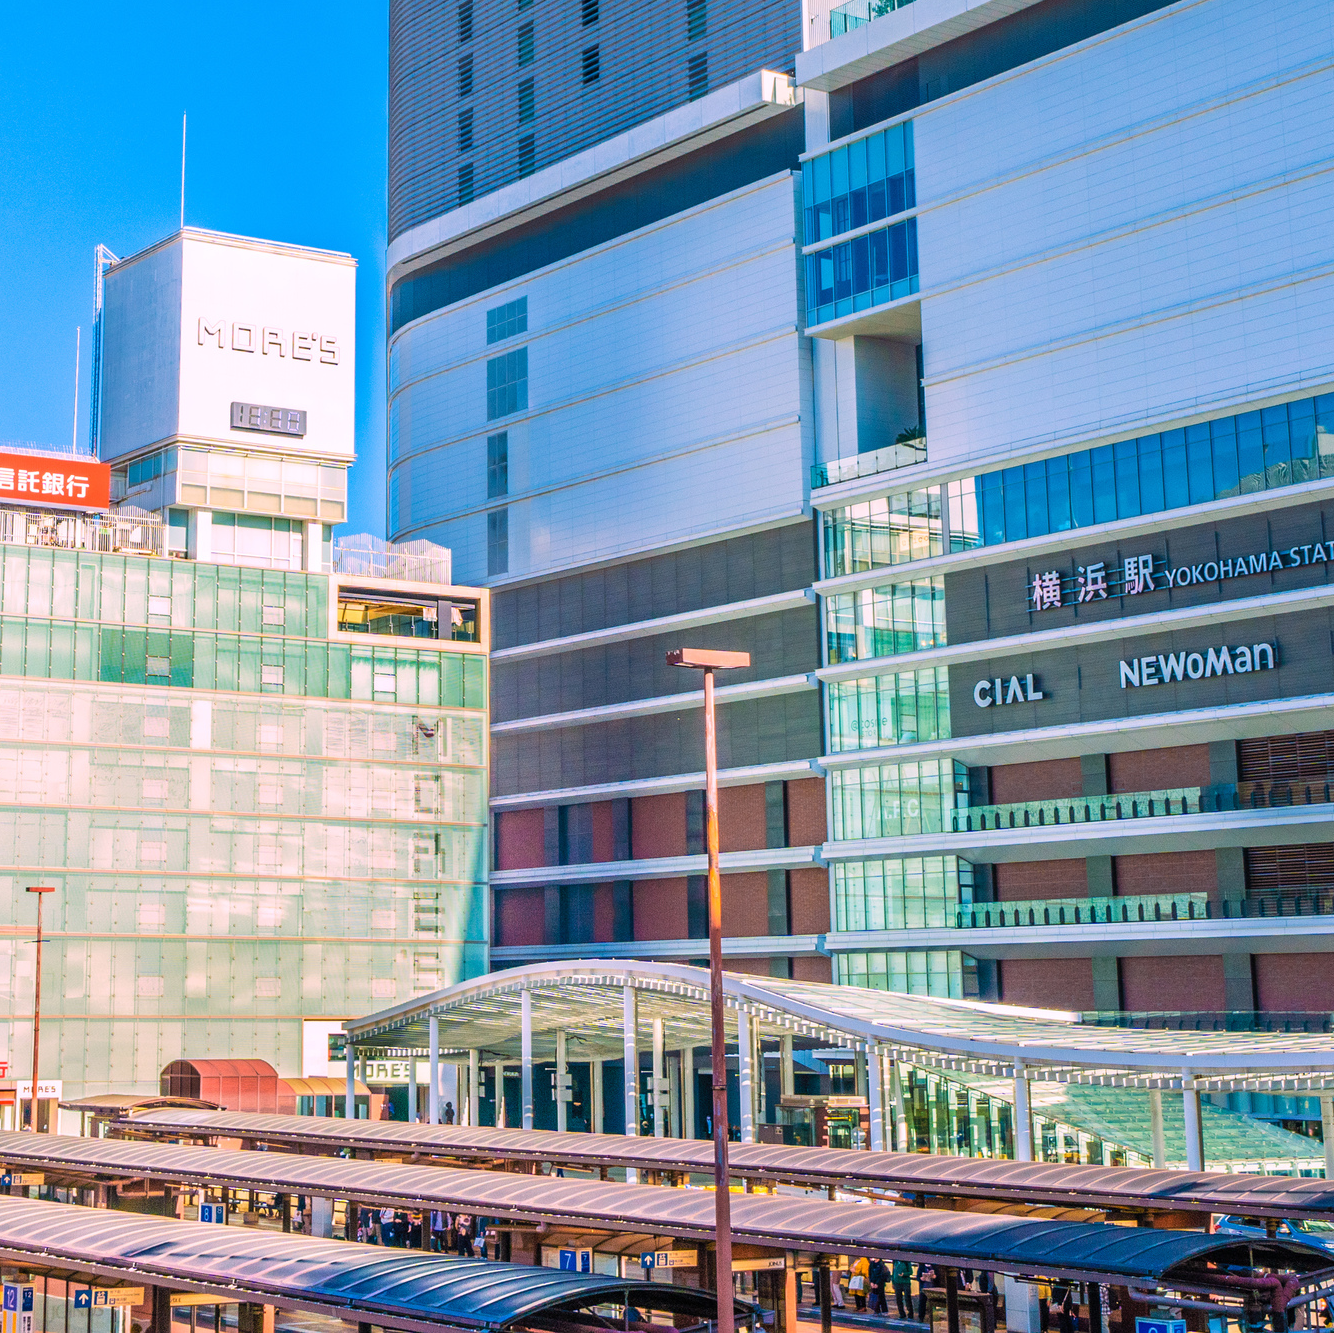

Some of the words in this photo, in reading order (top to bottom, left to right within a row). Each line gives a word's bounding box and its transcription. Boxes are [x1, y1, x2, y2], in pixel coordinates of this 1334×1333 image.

[198, 317, 340, 365] MORE'S
[1032, 554, 1156, 611] 横浜駅
[1165, 551, 1284, 588] YOKOHAMA
[1120, 643, 1275, 689] NEWoMan
[973, 673, 1043, 708] CIAL
[204, 1208, 209, 1221] 8
[565, 1253, 572, 1269] 7
[7, 1289, 14, 1308] 12
